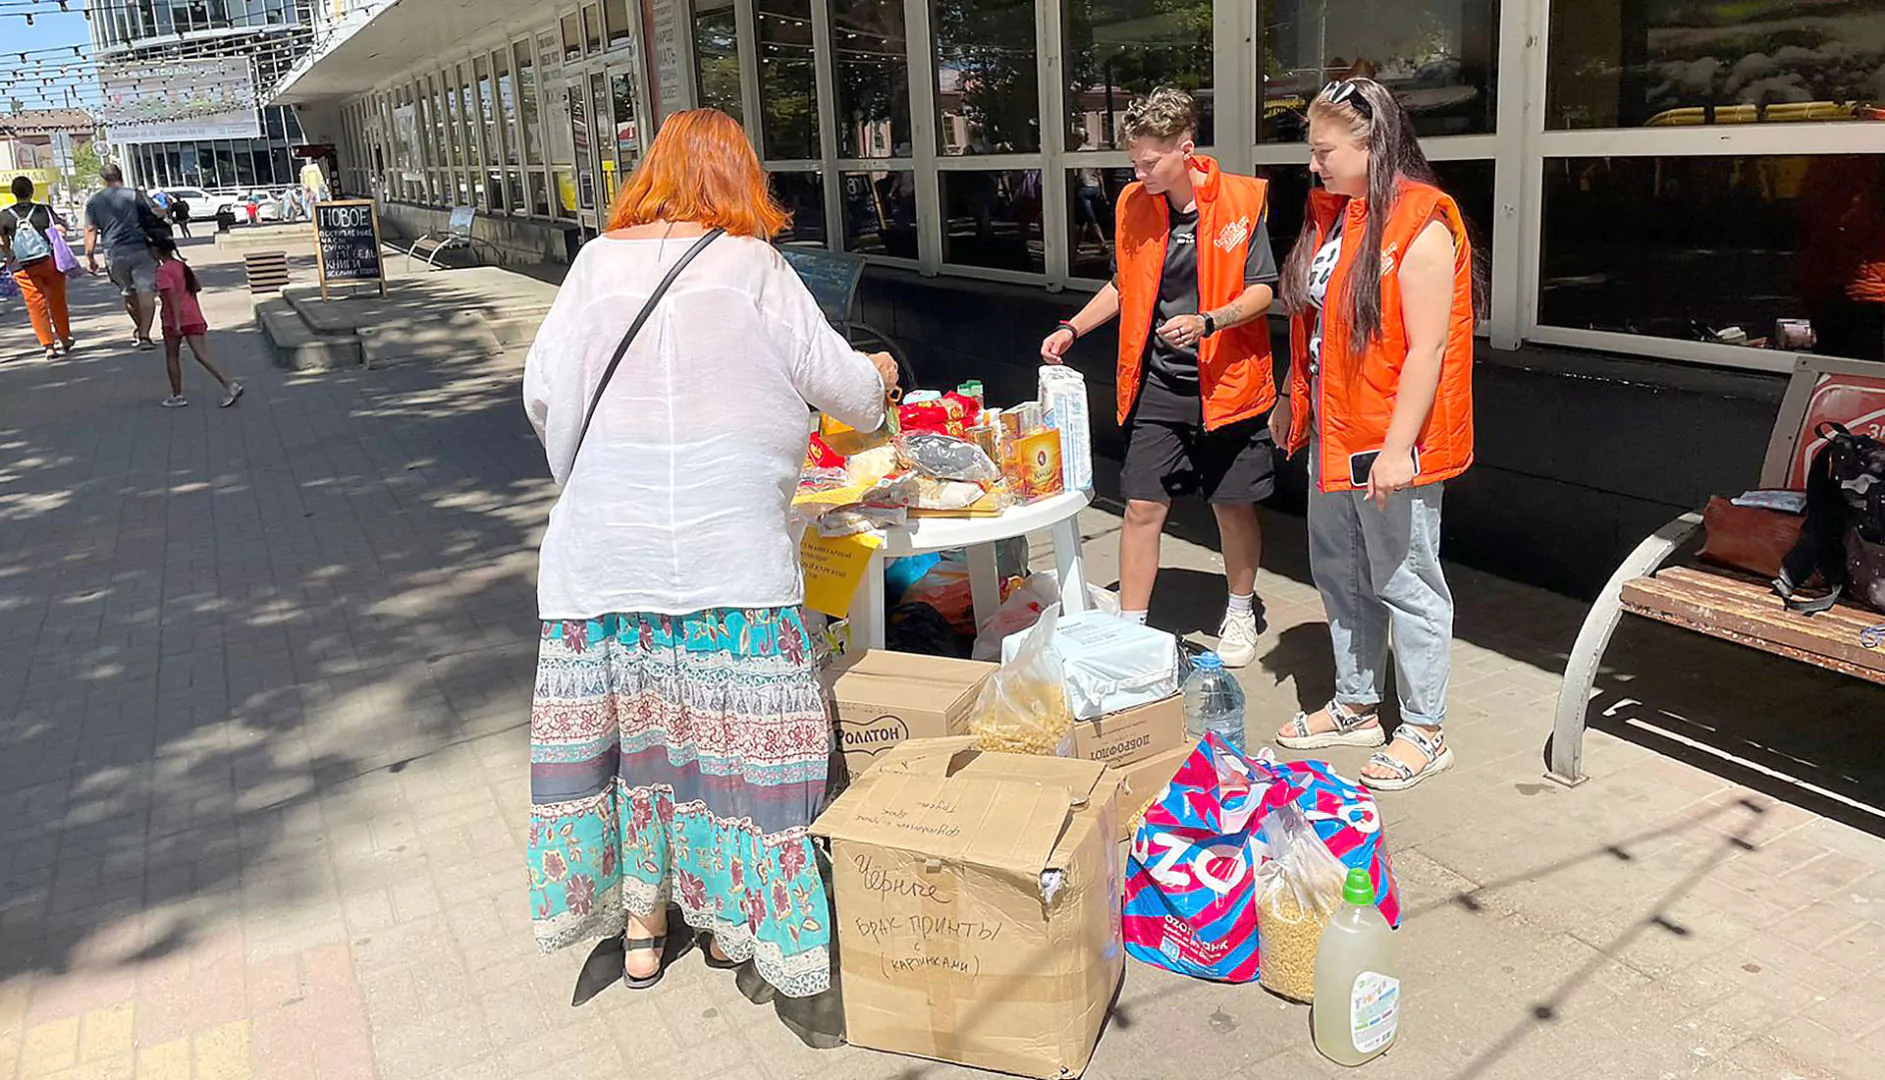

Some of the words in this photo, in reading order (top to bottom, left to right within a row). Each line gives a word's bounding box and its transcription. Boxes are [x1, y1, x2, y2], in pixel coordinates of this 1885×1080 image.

[319, 207, 369, 228] НОВОЕ
[834, 726, 899, 746] РОЛЛТОН
[855, 916, 903, 944] БРАК
[910, 915, 1003, 941] ПРИНТЫ
